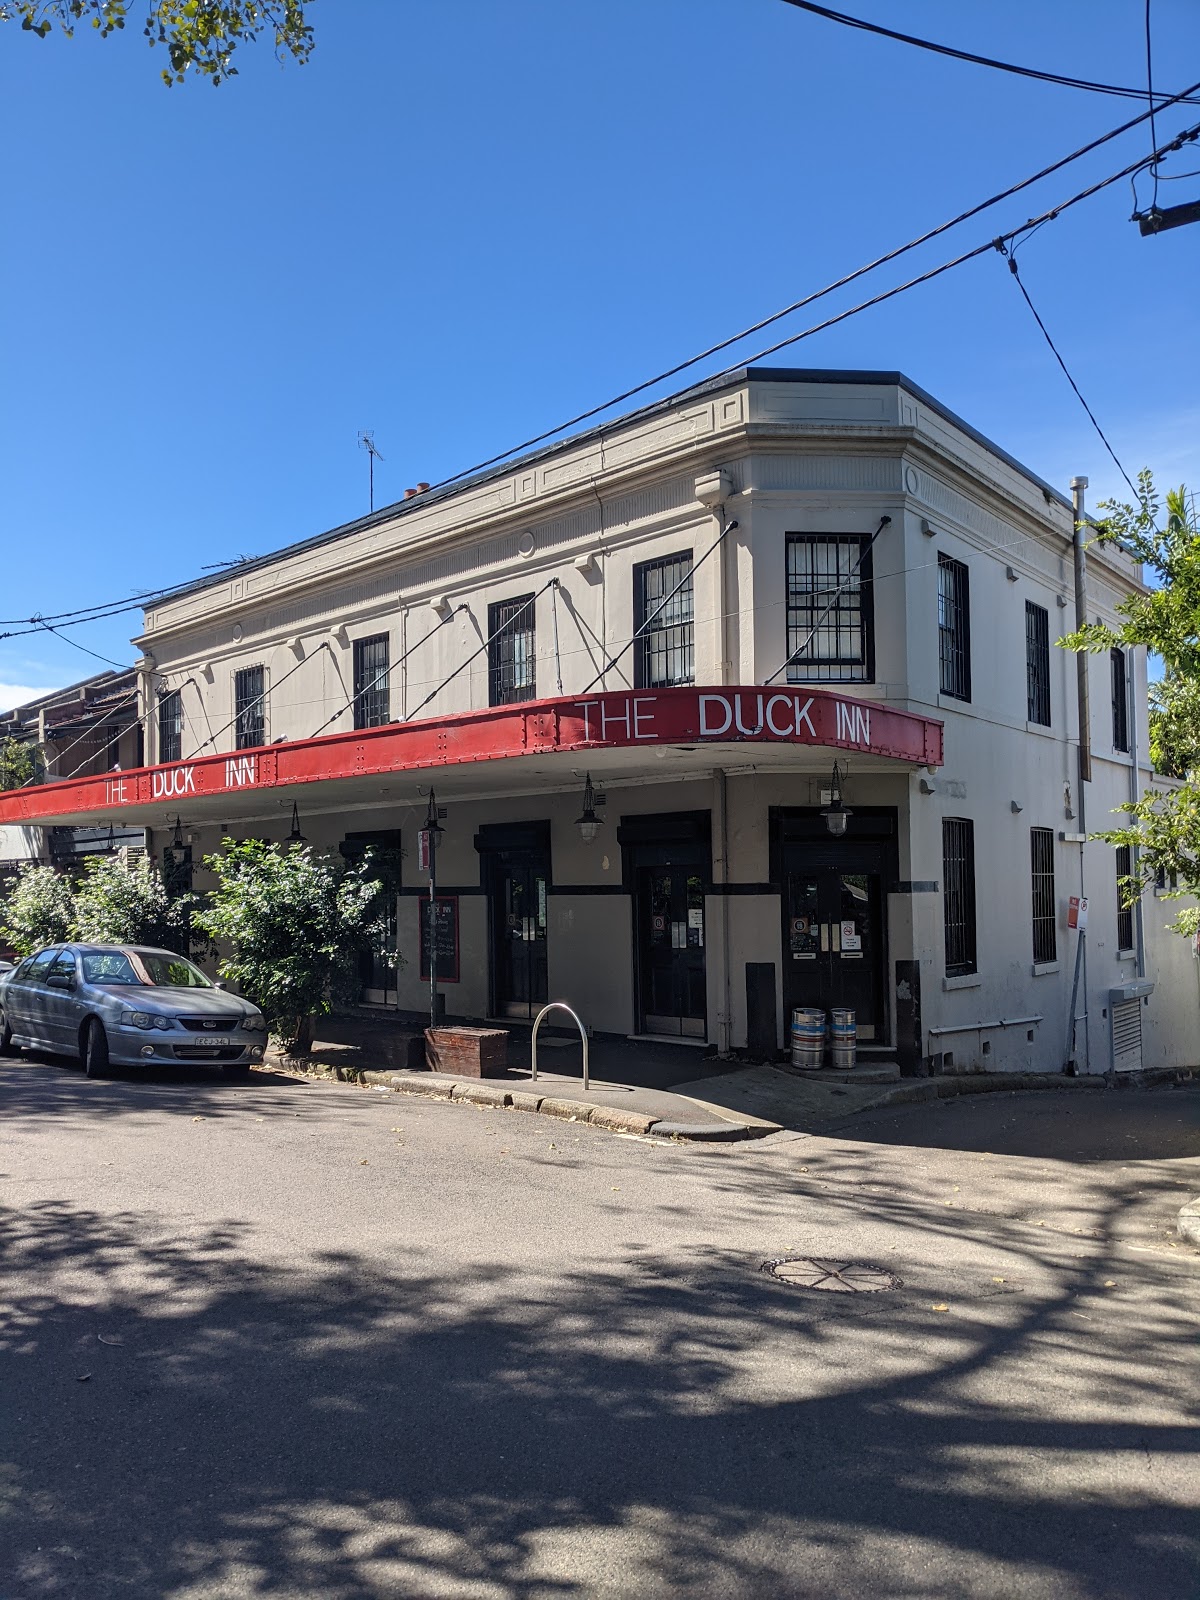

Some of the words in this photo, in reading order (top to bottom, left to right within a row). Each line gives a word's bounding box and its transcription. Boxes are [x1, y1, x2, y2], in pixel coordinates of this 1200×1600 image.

[574, 696, 660, 741] THE
[698, 694, 817, 737] DUCK
[836, 701, 870, 746] INN
[104, 776, 128, 803] THE
[153, 765, 195, 797] DUCK
[225, 755, 255, 787] INN
